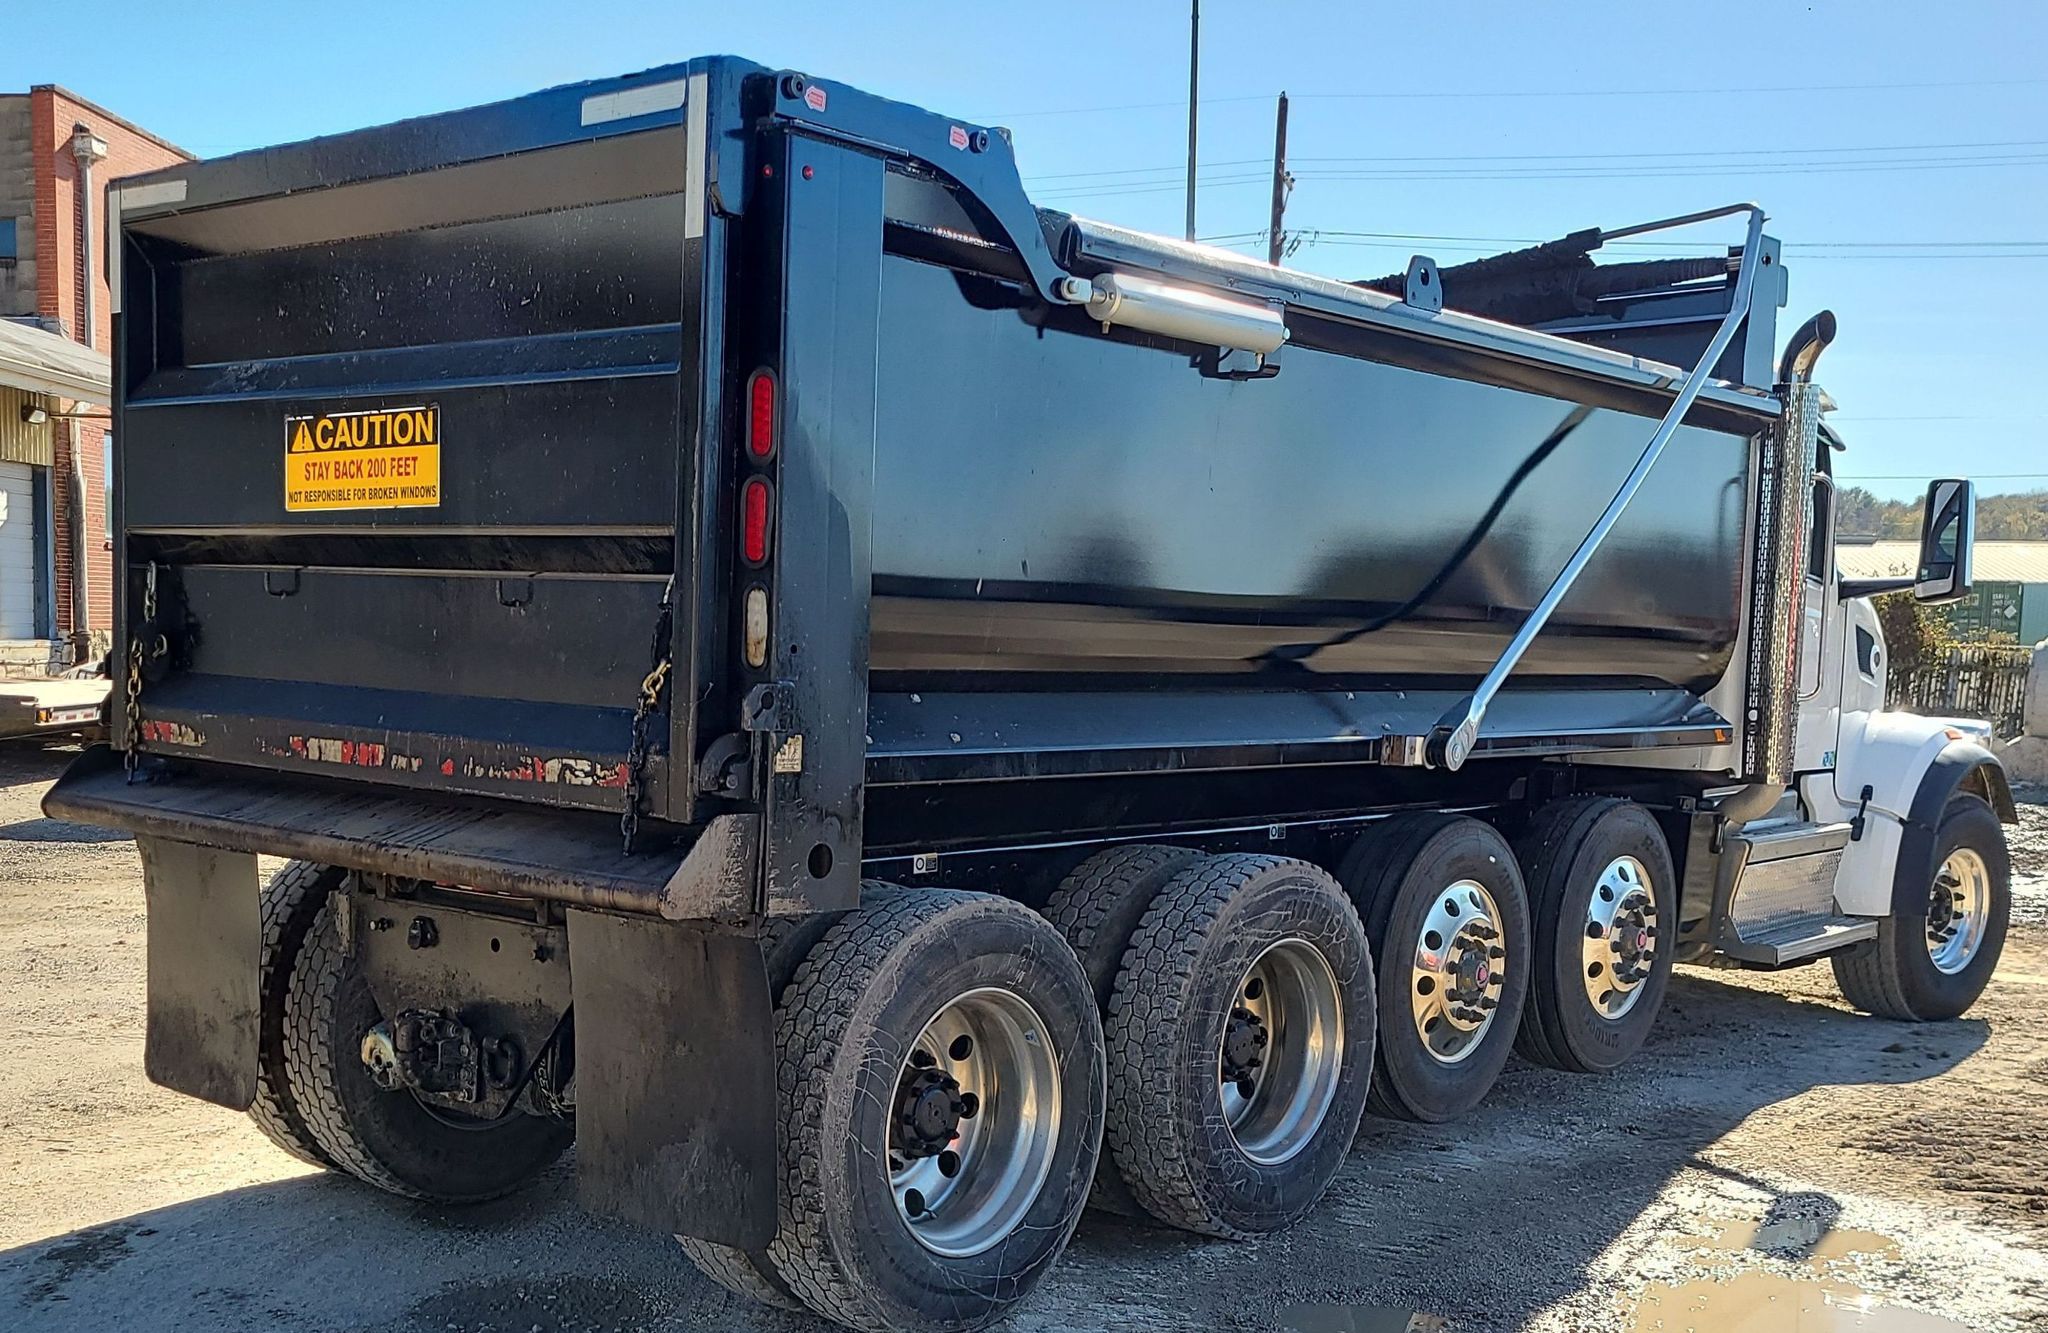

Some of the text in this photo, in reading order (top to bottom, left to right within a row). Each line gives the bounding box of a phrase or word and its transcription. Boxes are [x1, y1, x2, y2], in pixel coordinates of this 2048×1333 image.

[315, 411, 433, 449] CAUTION
[304, 456, 418, 481] STAY BACK 200 FEET
[289, 485, 437, 503] NOT RESPONSIBLE FOR BROKEN WINDOWS
